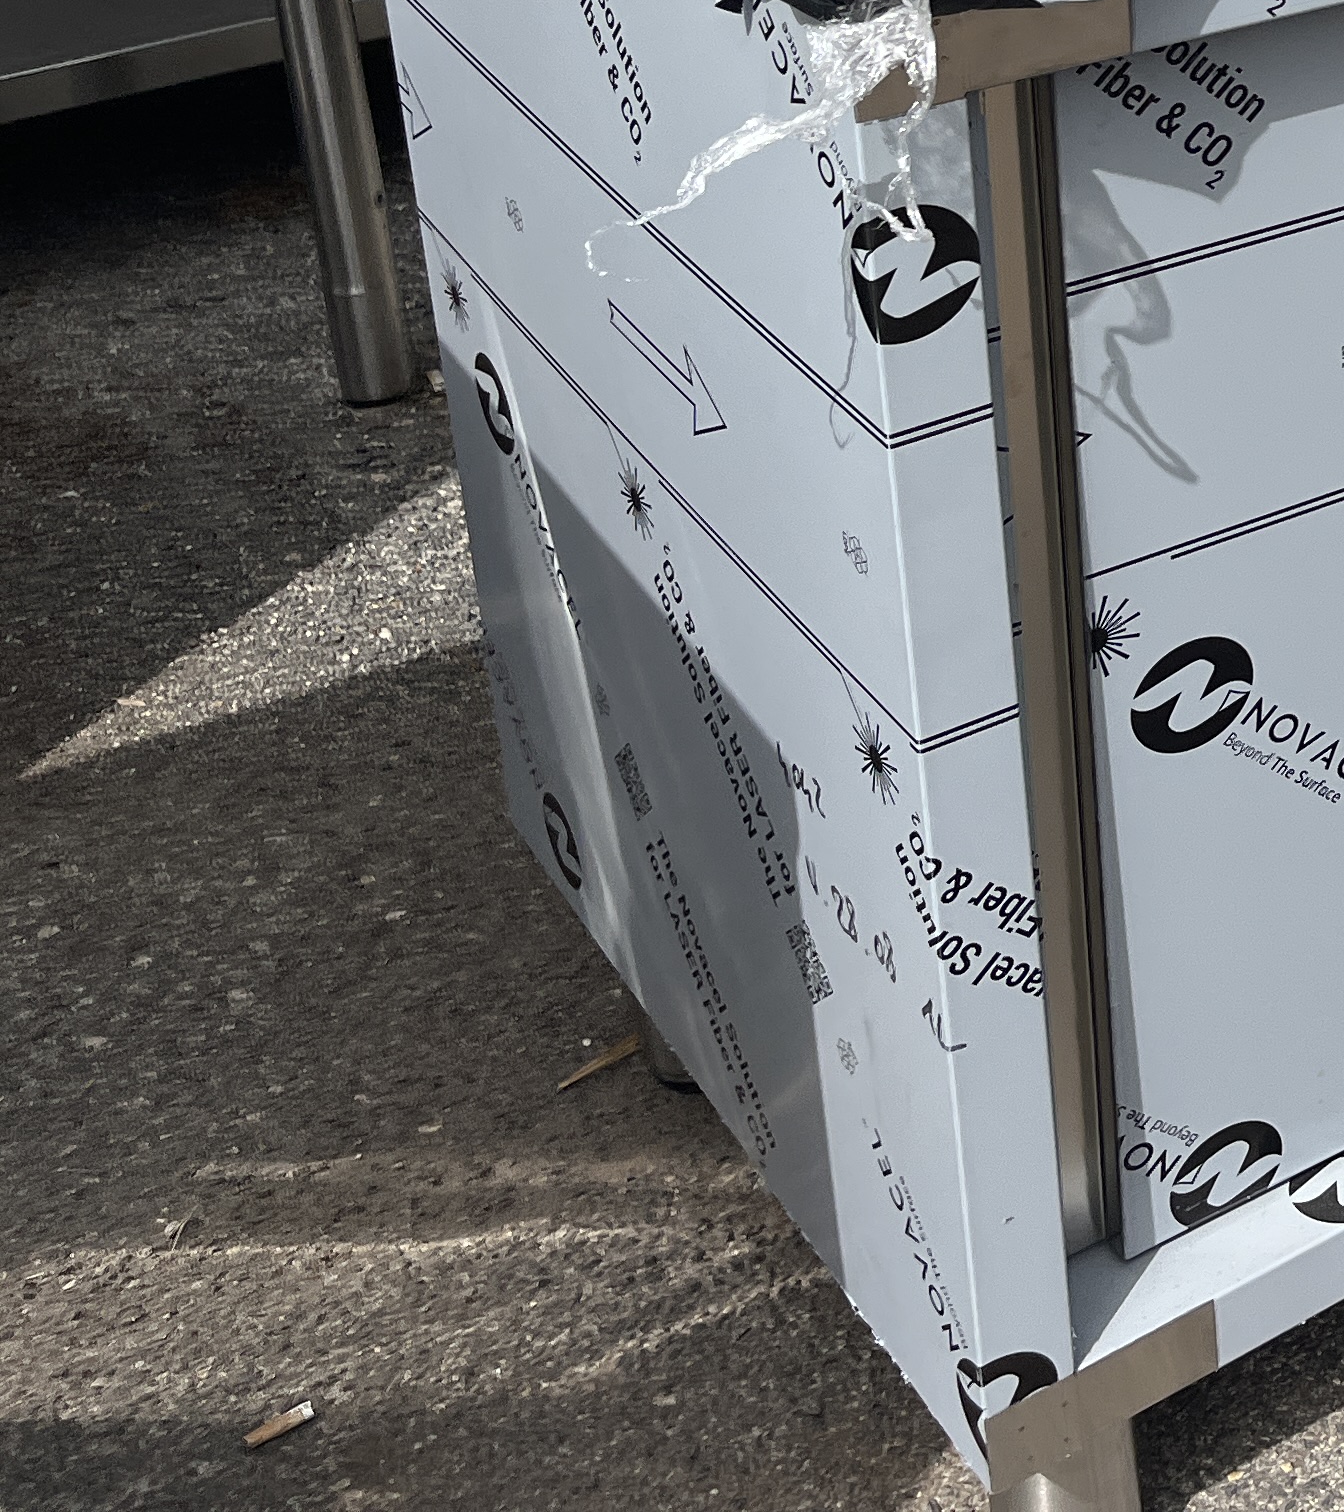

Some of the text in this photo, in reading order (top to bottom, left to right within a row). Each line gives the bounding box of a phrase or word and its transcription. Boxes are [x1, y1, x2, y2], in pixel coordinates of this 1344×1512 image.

[607, 64, 620, 93] &
[1154, 101, 1187, 141] &
[1183, 120, 1234, 192] CO2
[513, 453, 583, 642] NOVACEL
[683, 613, 697, 635] &
[696, 645, 735, 728] Fiber
[653, 574, 785, 909] The Novacel Solution
[1223, 731, 1342, 804] Beyond The Surface
[731, 730, 777, 845] LASER
[769, 851, 797, 896] for
[895, 842, 983, 976] Solution
[939, 867, 973, 905] &
[645, 840, 747, 1106] for LASER Fiber &
[655, 830, 778, 1151] The Novacel Solution
[1125, 1107, 1199, 1147] Beyond The
[870, 1127, 962, 1352] NOVACEL
